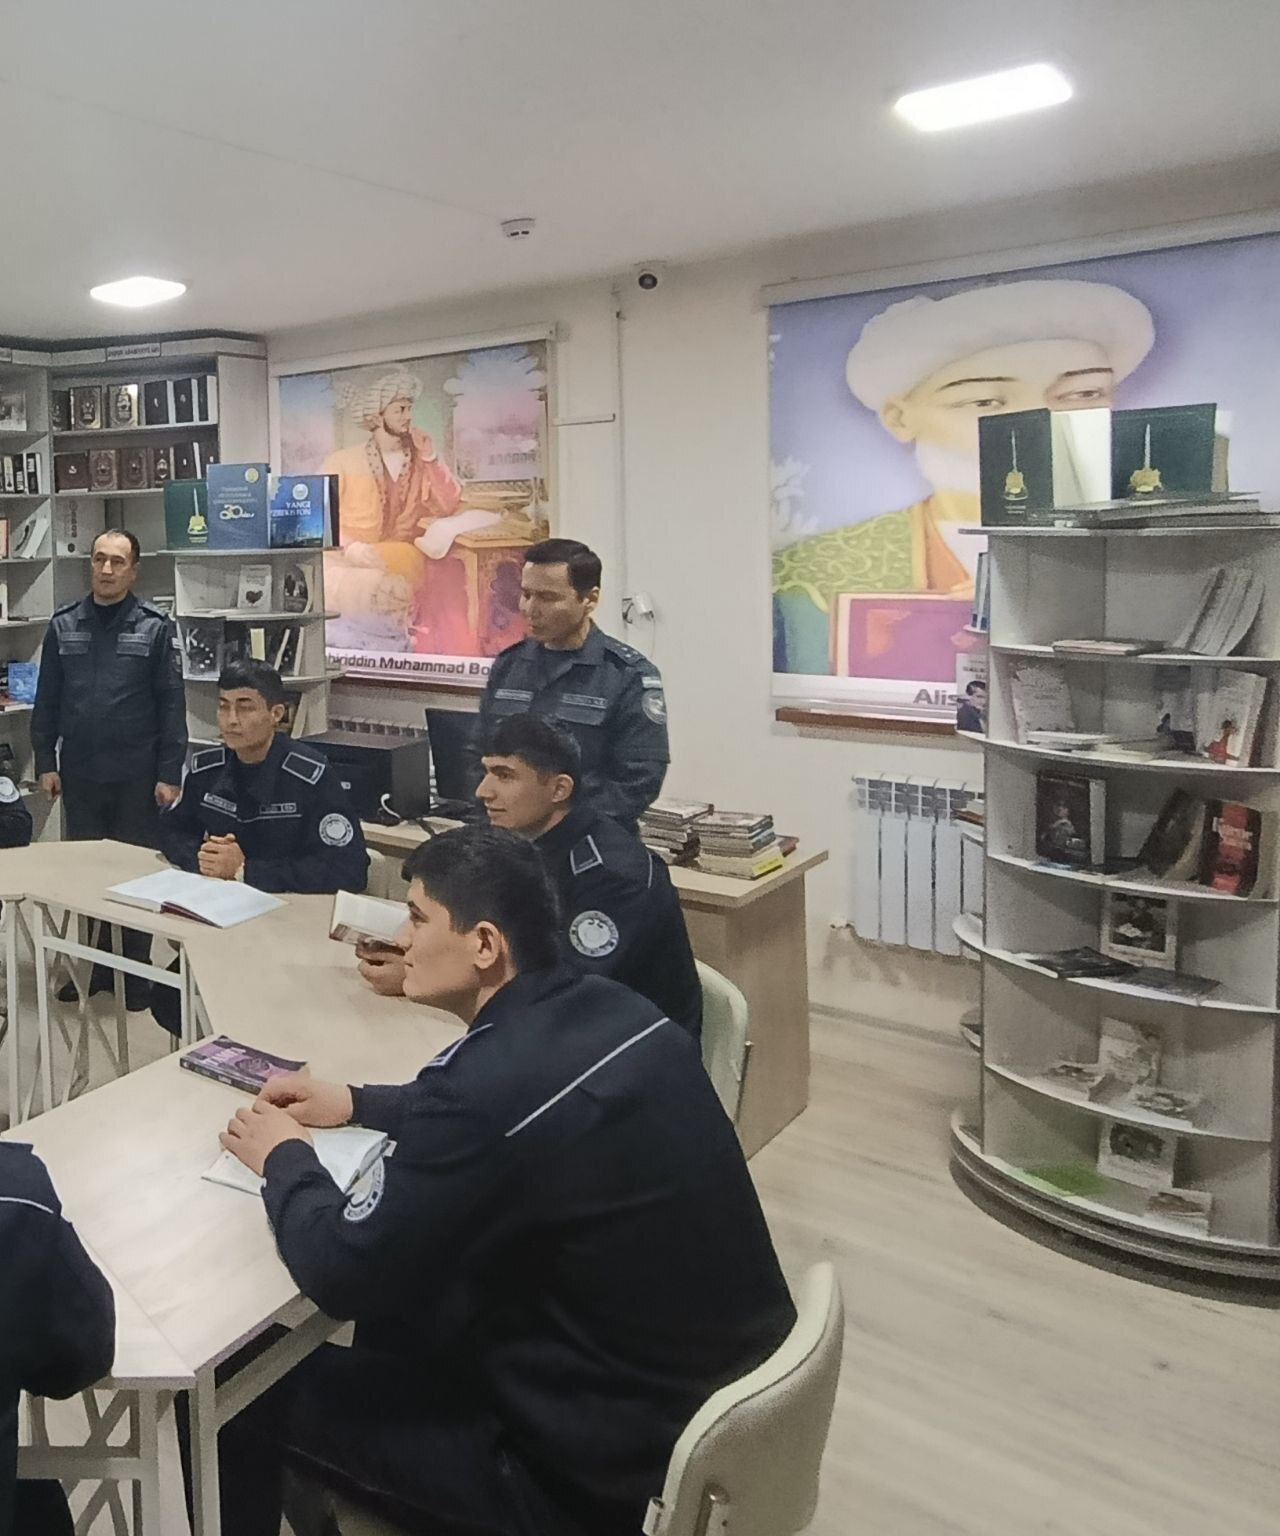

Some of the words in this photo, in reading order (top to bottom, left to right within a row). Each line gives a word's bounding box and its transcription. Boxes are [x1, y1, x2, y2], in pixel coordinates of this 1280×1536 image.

[285, 501, 311, 509] YANGI
[328, 653, 376, 669] hiriddin
[379, 656, 466, 675] Muhammad
[469, 662, 490, 677] Bo
[912, 688, 958, 706] Alis
